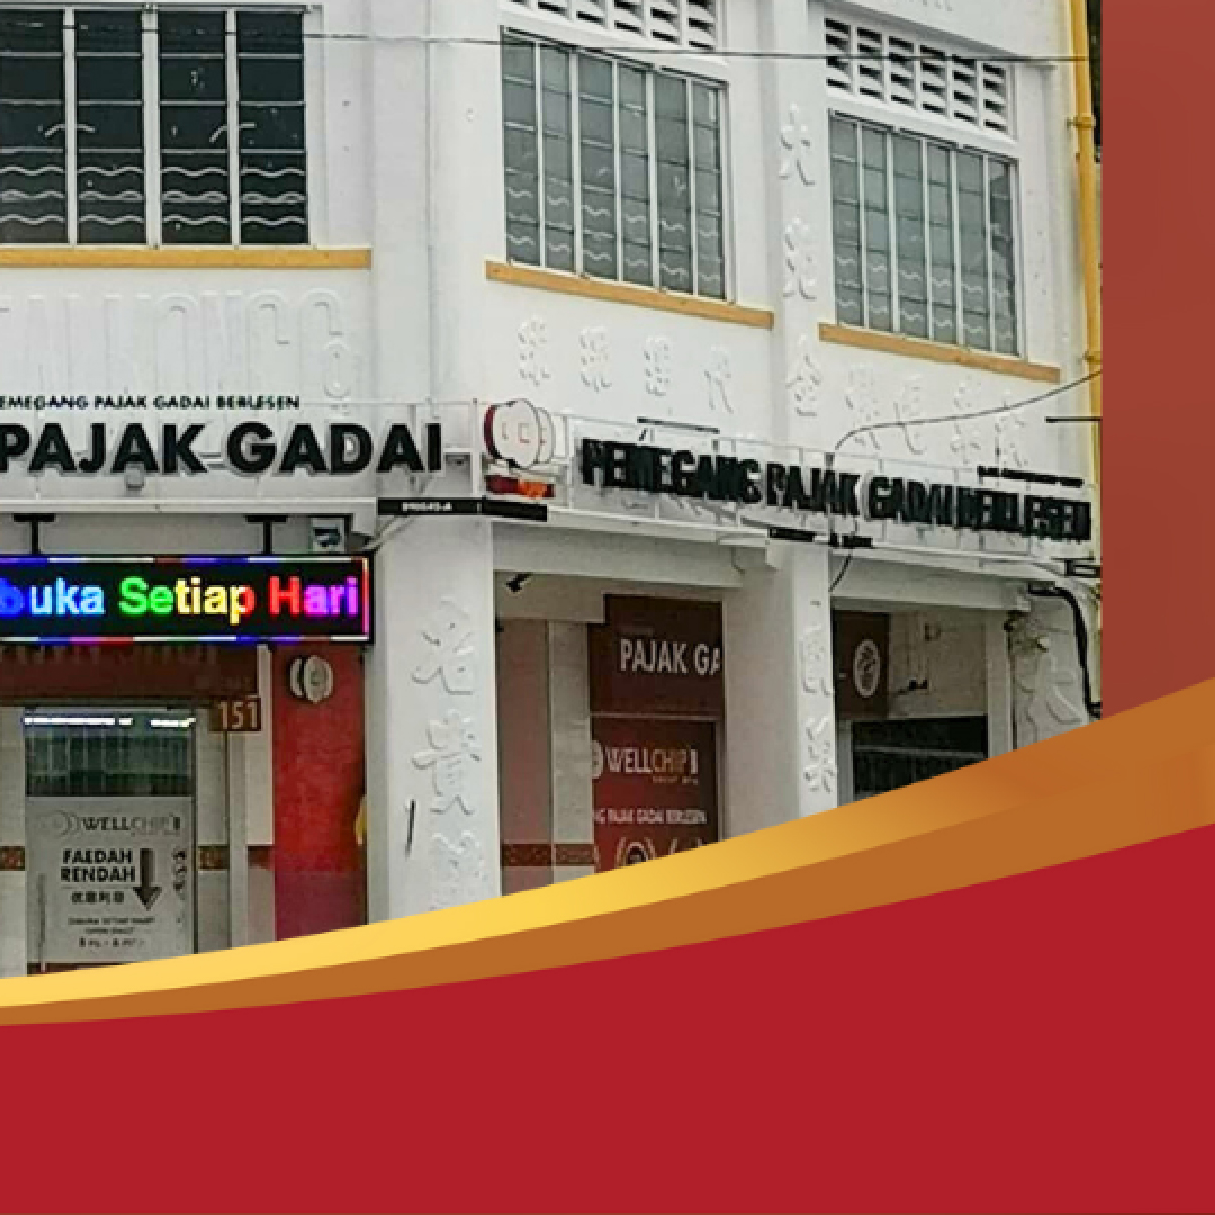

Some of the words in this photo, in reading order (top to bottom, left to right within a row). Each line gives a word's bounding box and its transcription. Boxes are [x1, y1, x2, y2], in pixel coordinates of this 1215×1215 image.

[93, 395, 147, 411] PAJAK
[152, 395, 210, 411] GADAI
[215, 395, 301, 411] BERLESEN
[225, 421, 443, 475] GADAI
[119, 575, 256, 627] Setiap
[267, 576, 359, 618] Hari
[619, 637, 687, 675] PAJAK
[217, 700, 260, 730] 151
